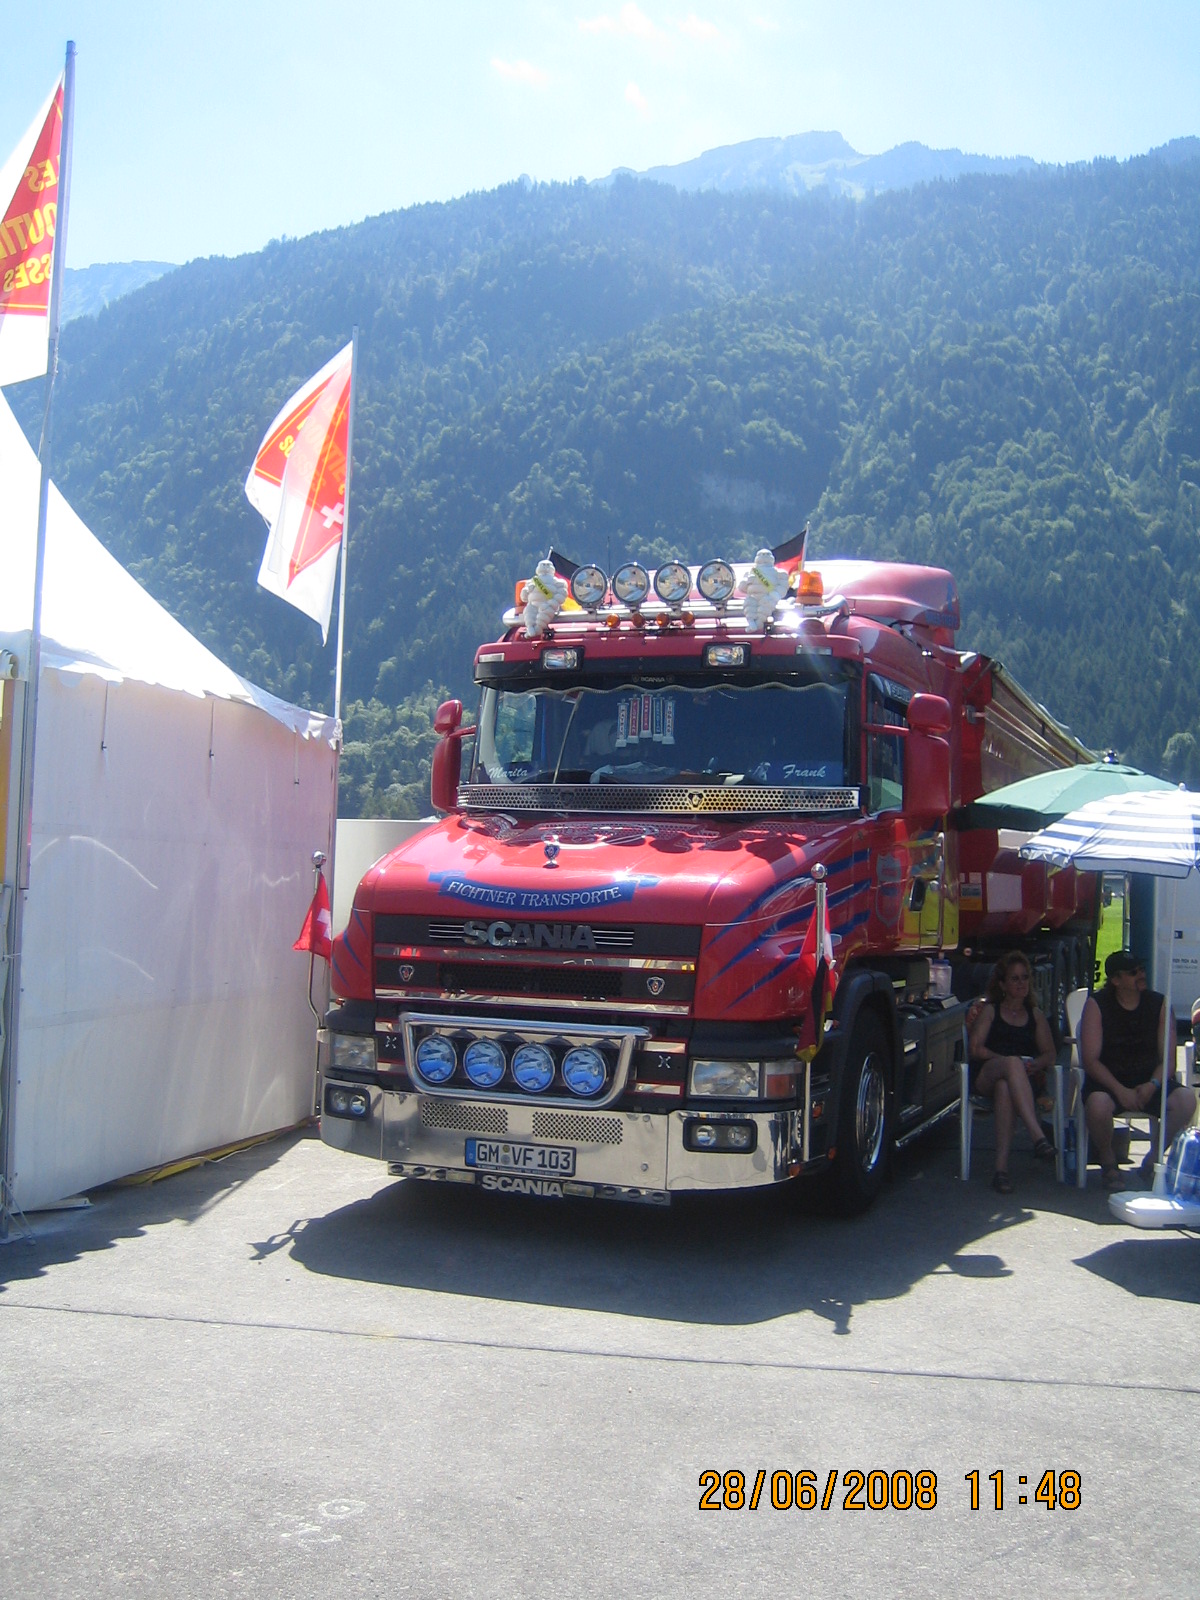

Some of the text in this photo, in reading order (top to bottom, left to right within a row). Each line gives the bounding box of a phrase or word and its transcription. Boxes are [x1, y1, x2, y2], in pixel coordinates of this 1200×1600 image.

[488, 767, 528, 778] Marita
[783, 764, 827, 779] Frank
[447, 881, 622, 907] FICHTNER TRANSPORTE
[462, 920, 598, 950] SCANIA
[477, 1143, 500, 1163] GM
[511, 1146, 534, 1166] VF
[537, 1149, 571, 1170] 103
[481, 1174, 564, 1198] SCANIA
